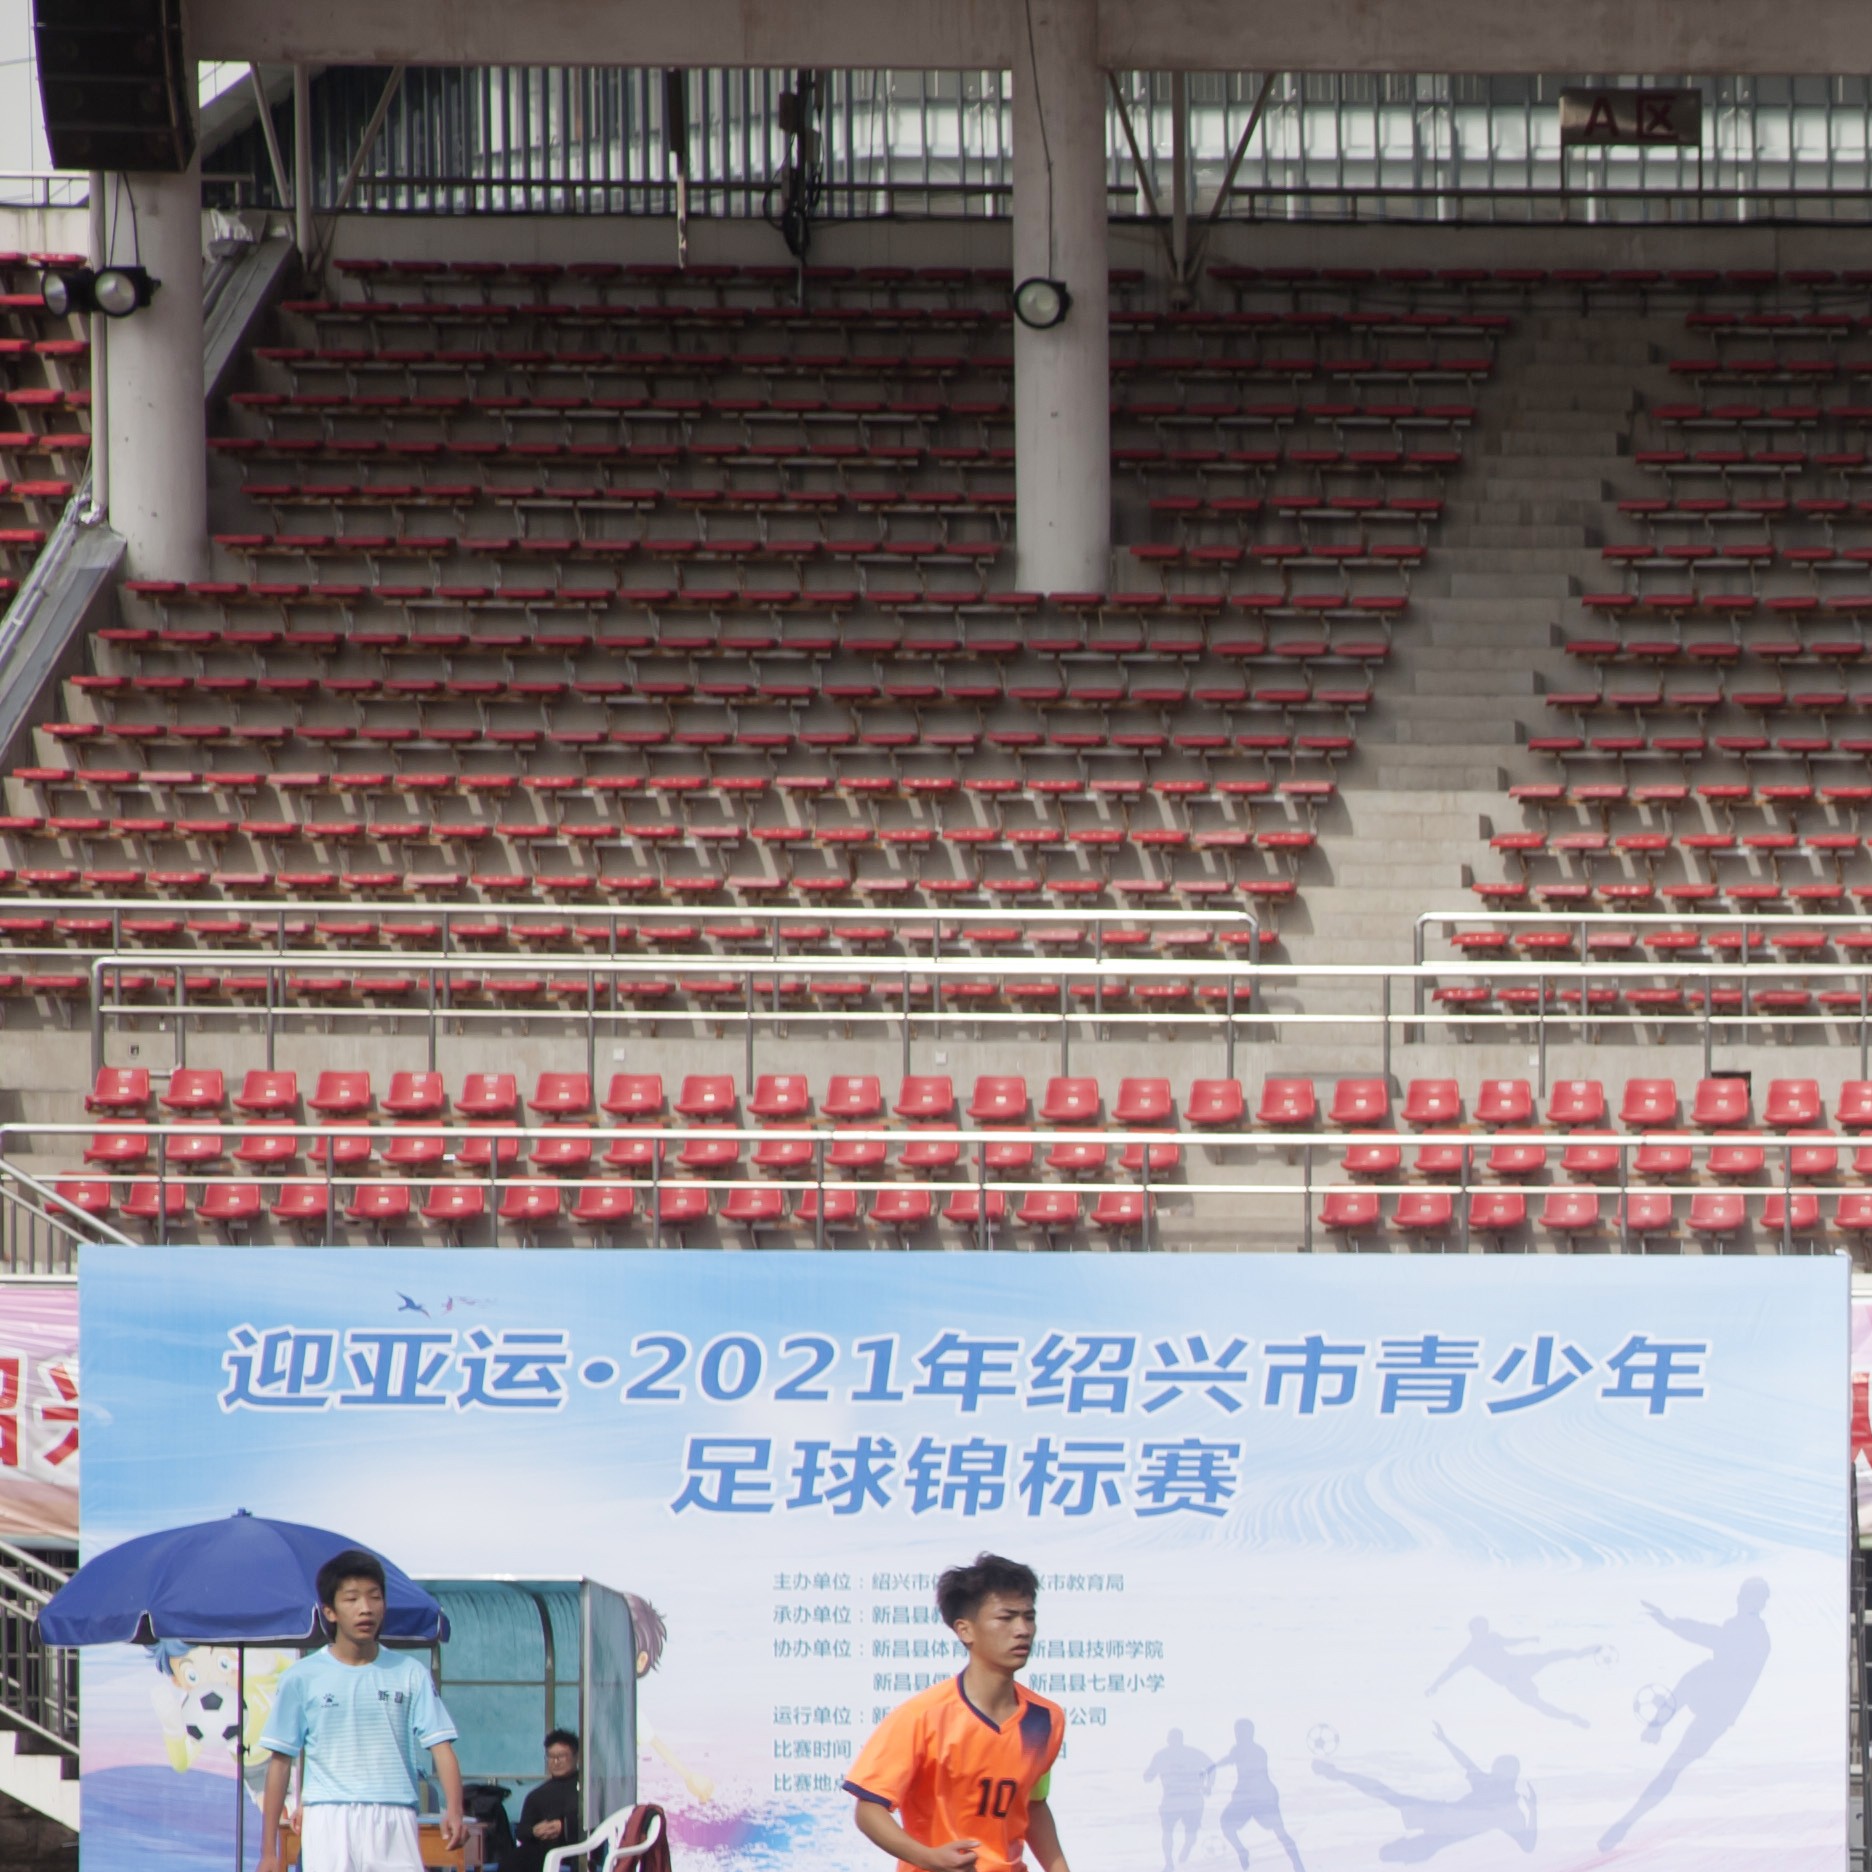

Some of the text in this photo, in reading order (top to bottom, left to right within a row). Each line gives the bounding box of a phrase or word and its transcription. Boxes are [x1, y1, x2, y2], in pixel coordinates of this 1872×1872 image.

[671, 1437, 1243, 1519] 足球锦标赛
[1029, 1673, 1165, 1692] 新昌县七星小学
[1064, 1706, 1106, 1725] 公司
[975, 1777, 1018, 1818] 10
